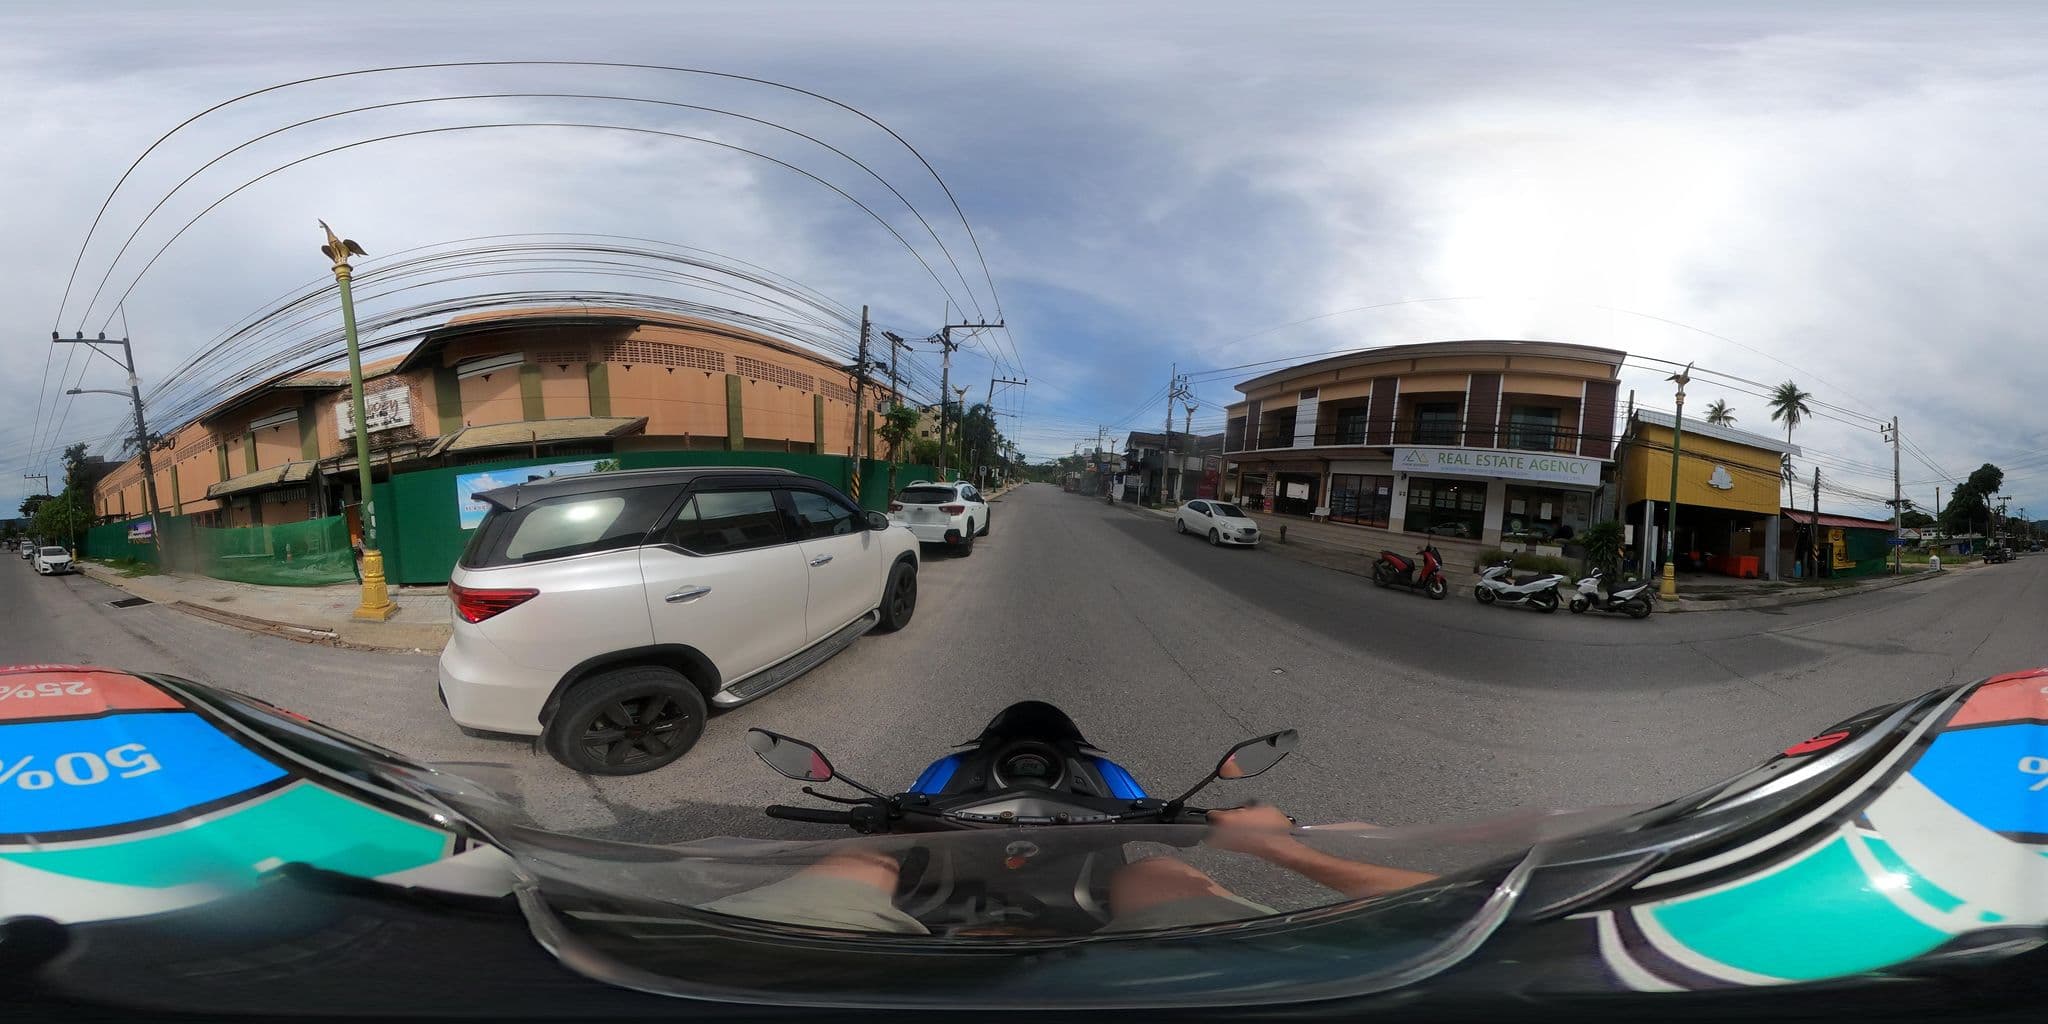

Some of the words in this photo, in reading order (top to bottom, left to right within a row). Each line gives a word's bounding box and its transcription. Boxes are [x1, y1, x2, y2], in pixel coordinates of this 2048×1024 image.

[1438, 452, 1471, 465] REAL
[1475, 454, 1524, 469] ESTATE
[1529, 458, 1588, 474] AGENCY
